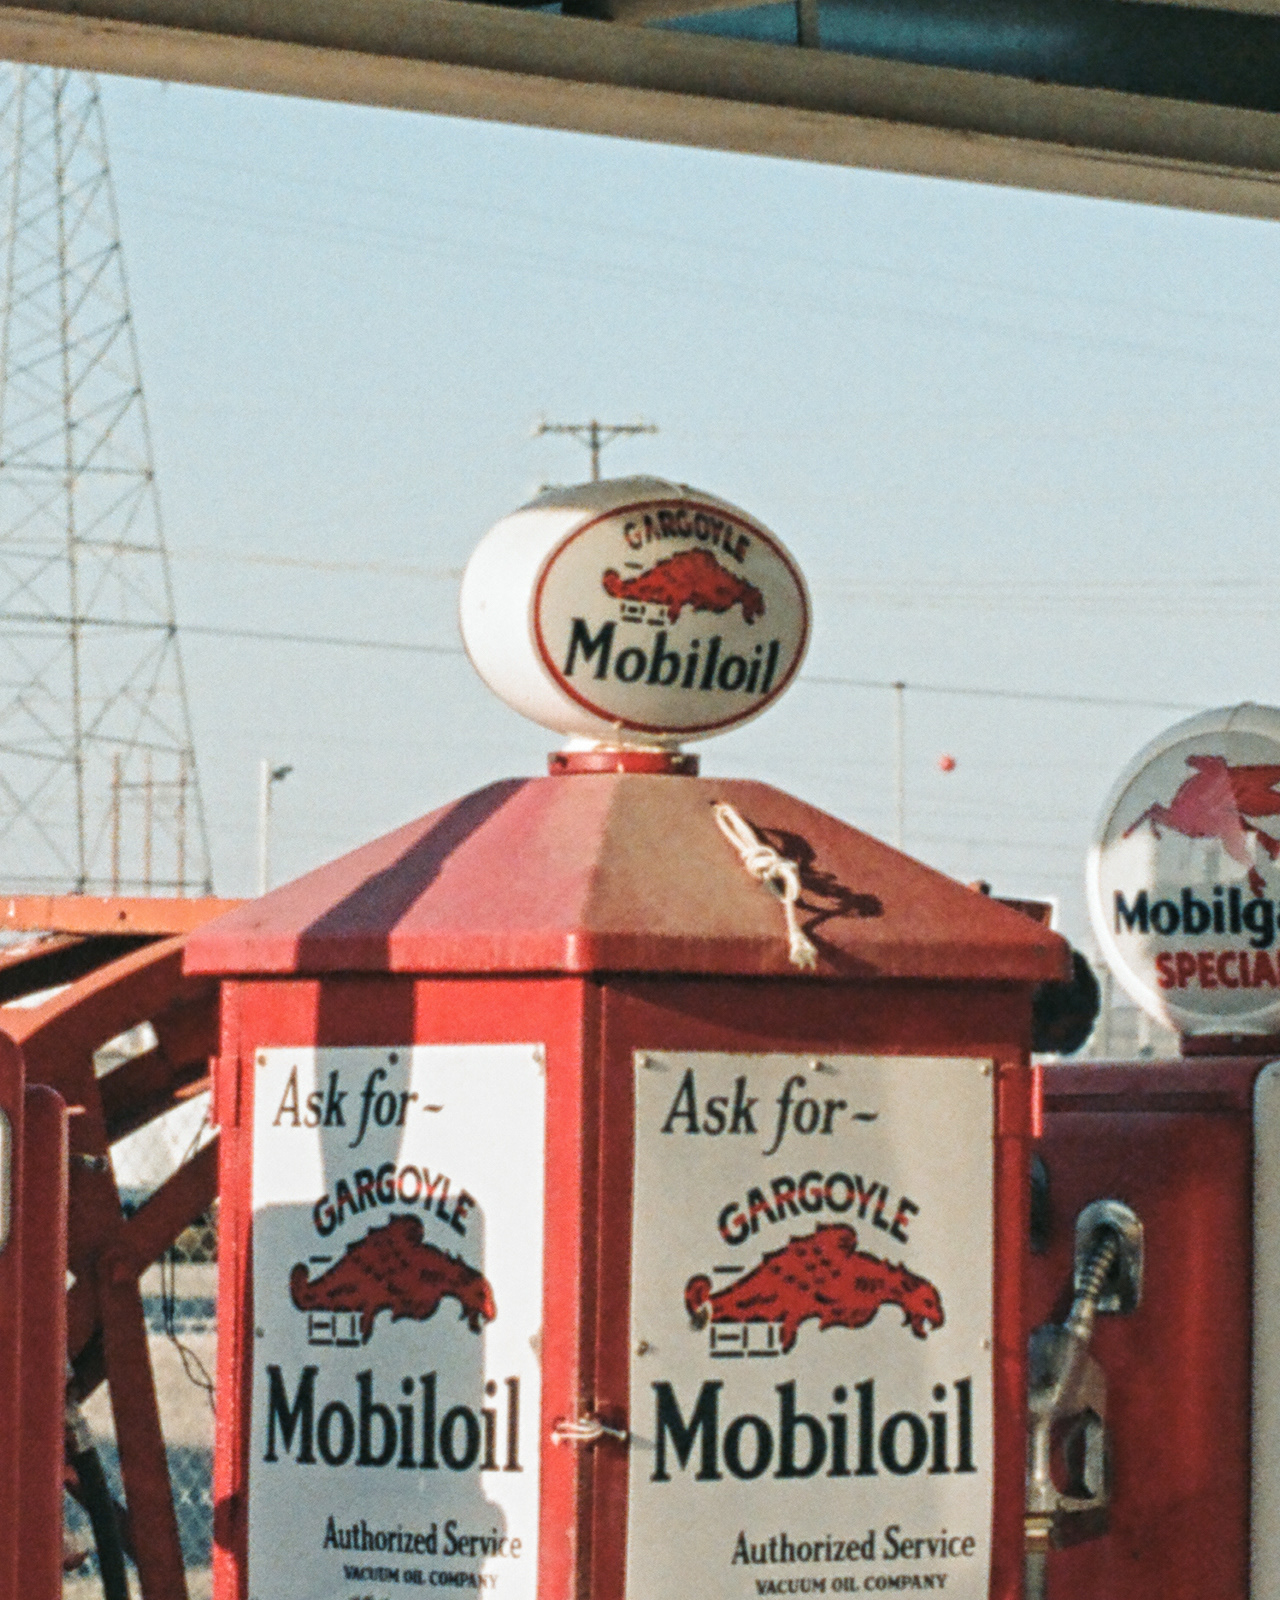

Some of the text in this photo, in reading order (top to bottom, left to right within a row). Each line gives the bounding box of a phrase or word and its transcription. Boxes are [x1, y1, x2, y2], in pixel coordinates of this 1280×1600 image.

[624, 508, 752, 563] GARGOYLE
[563, 617, 782, 694] Mobiloil
[272, 1064, 348, 1128] Ask
[660, 1067, 759, 1135] Ask
[312, 1162, 476, 1238] GARGOYLE
[717, 1170, 920, 1246] GARGOYLE
[263, 1364, 524, 1473] Mobiloil
[650, 1376, 979, 1483] Mobiloil
[323, 1513, 523, 1558] Authorized Service
[731, 1524, 976, 1565] Authorized Service
[343, 1564, 500, 1589] VACUUM OIL COMPANY
[755, 1573, 948, 1596] VACUUM OIL COMPANY
